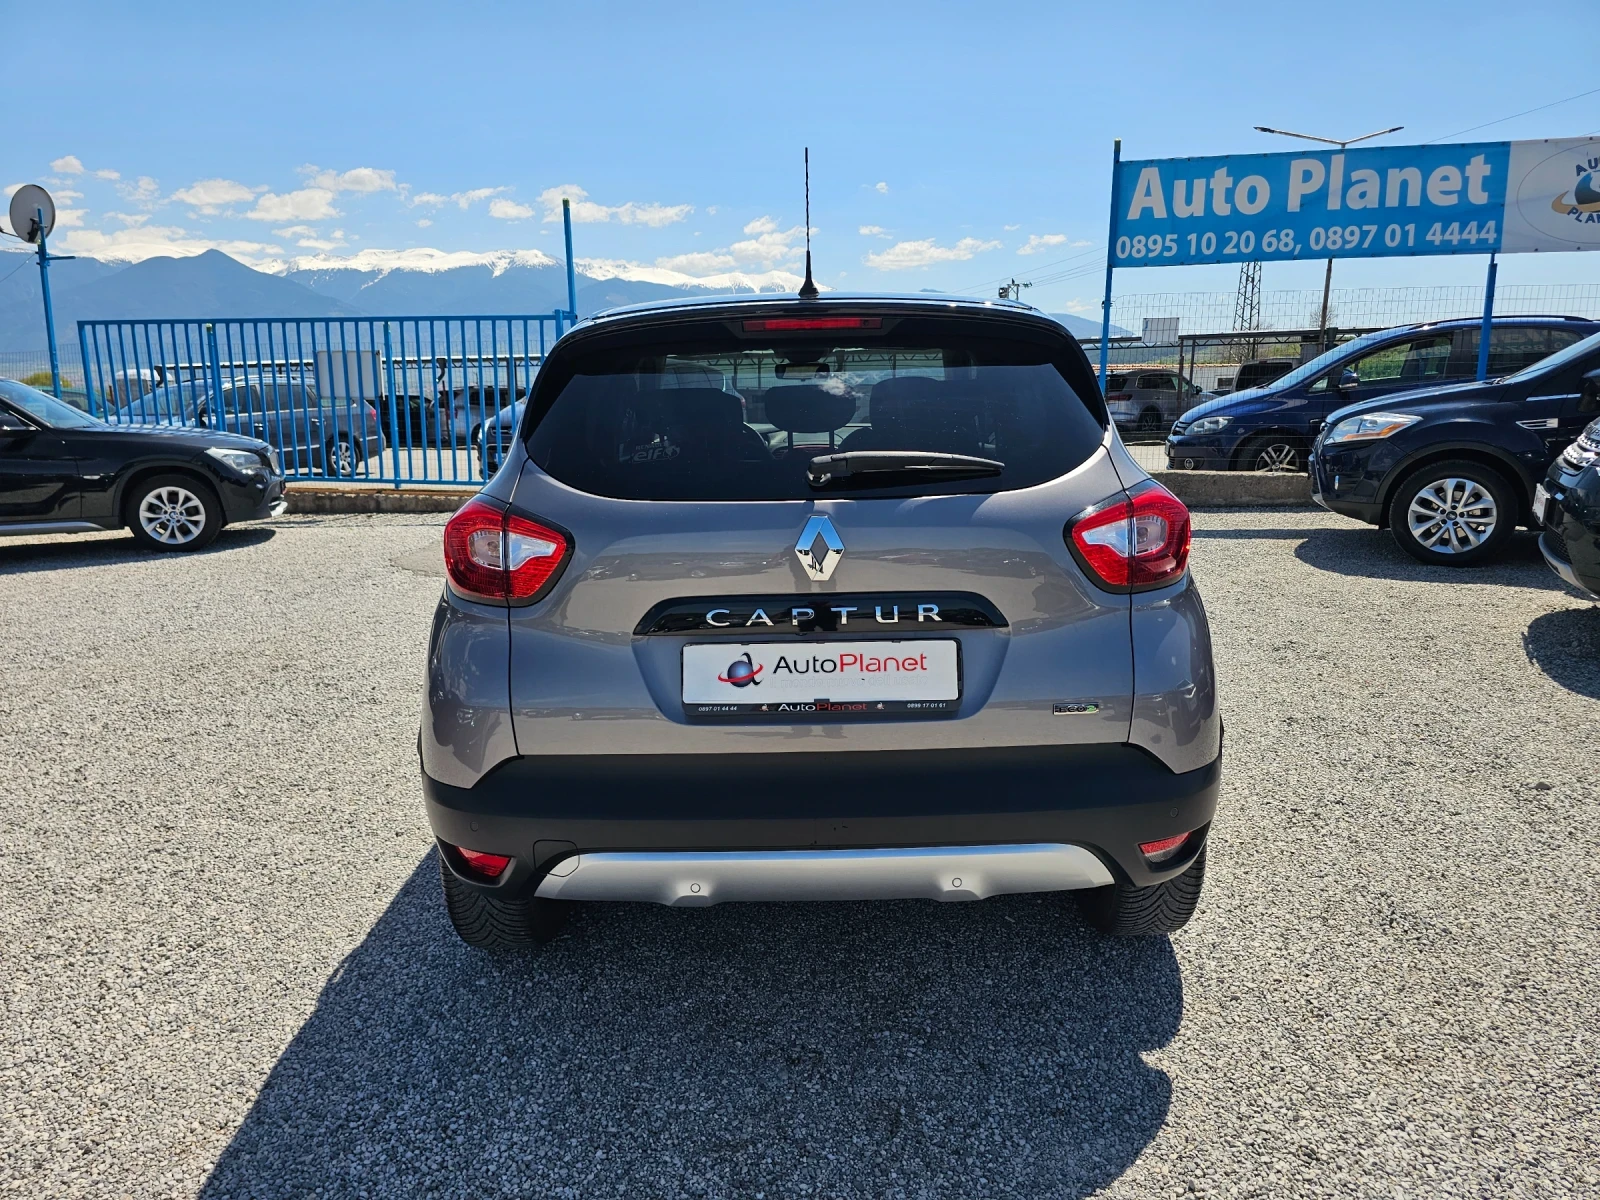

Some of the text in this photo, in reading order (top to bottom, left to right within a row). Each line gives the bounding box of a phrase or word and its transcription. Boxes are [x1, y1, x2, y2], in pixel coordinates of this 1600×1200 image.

[1575, 156, 1600, 177] AU
[1126, 153, 1492, 221] Auto Planet
[1567, 206, 1600, 224] PLA
[1115, 220, 1498, 259] 0895 10 20 68, 0897 01 4444
[705, 604, 943, 627] CAPTUR
[773, 652, 928, 675] AutoPlanet
[778, 702, 868, 712] AutoPlanet
